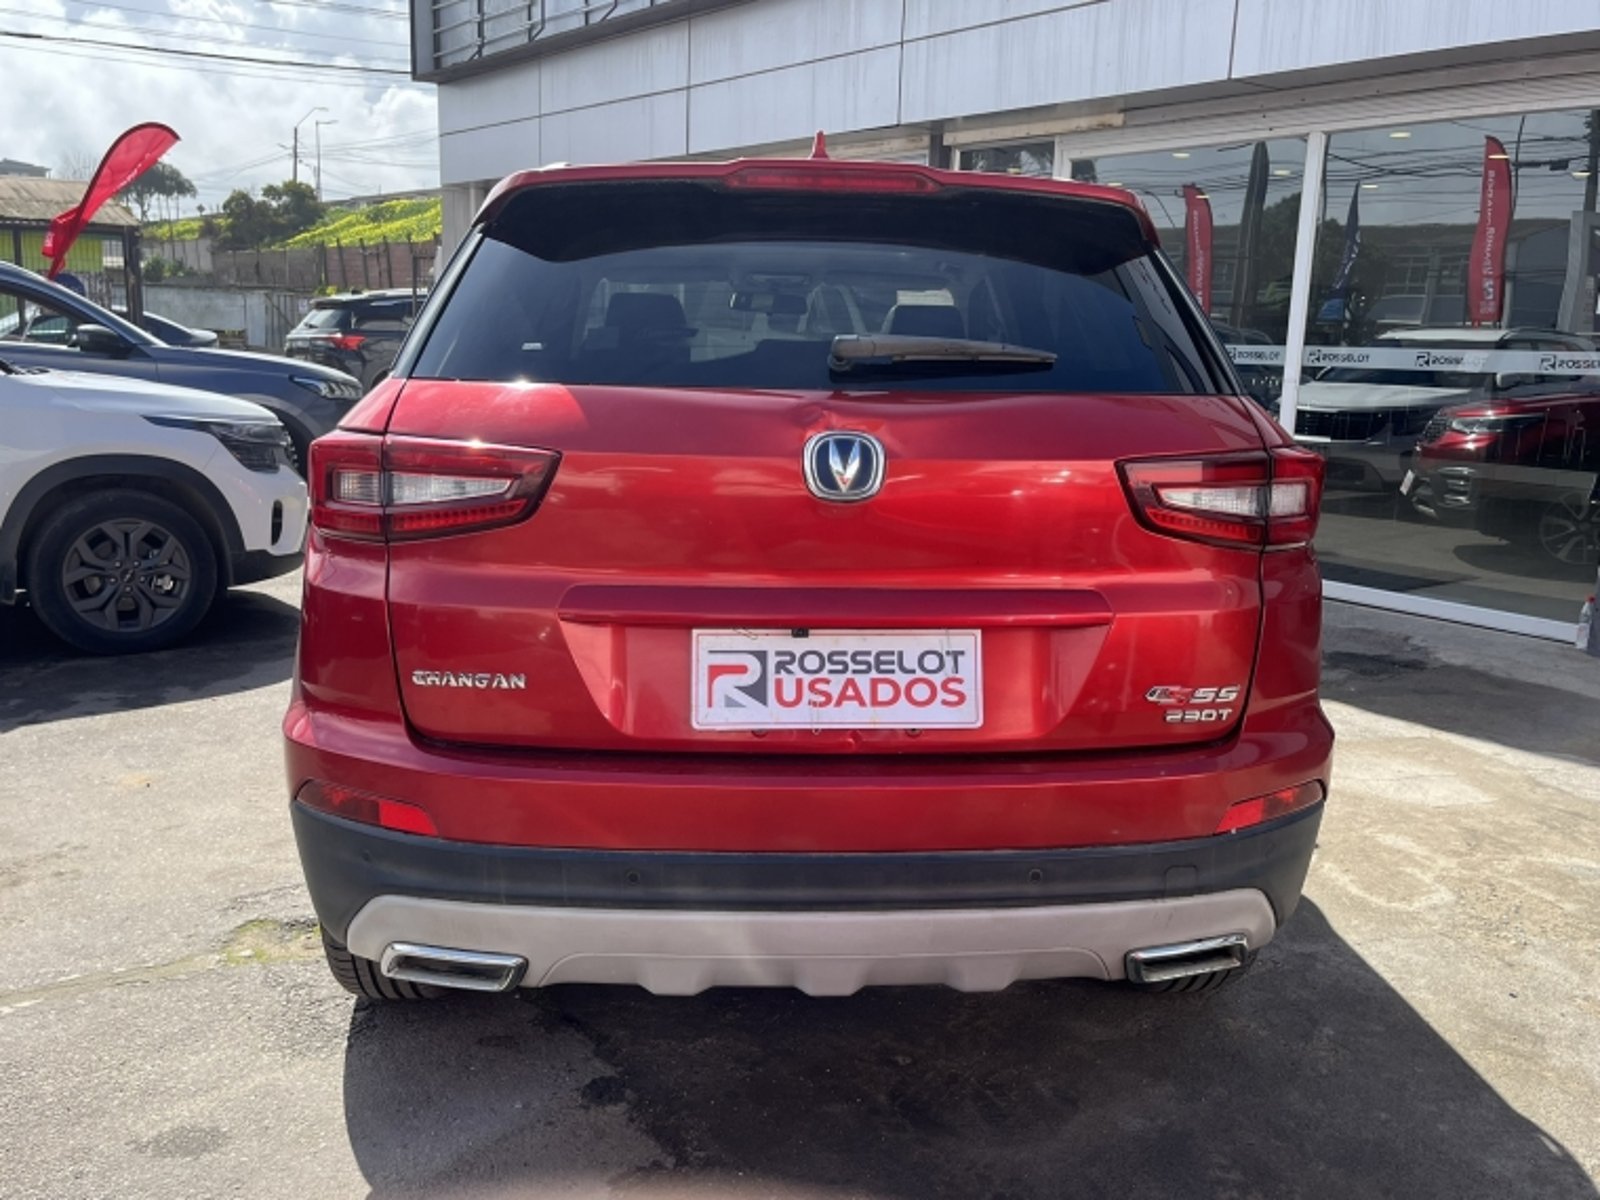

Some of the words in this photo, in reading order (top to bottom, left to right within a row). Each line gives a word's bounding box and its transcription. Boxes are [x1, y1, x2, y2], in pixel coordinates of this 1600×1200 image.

[774, 650, 965, 674] ROSSELOT
[411, 670, 527, 689] CHANGAN
[774, 677, 967, 708] USADOS
